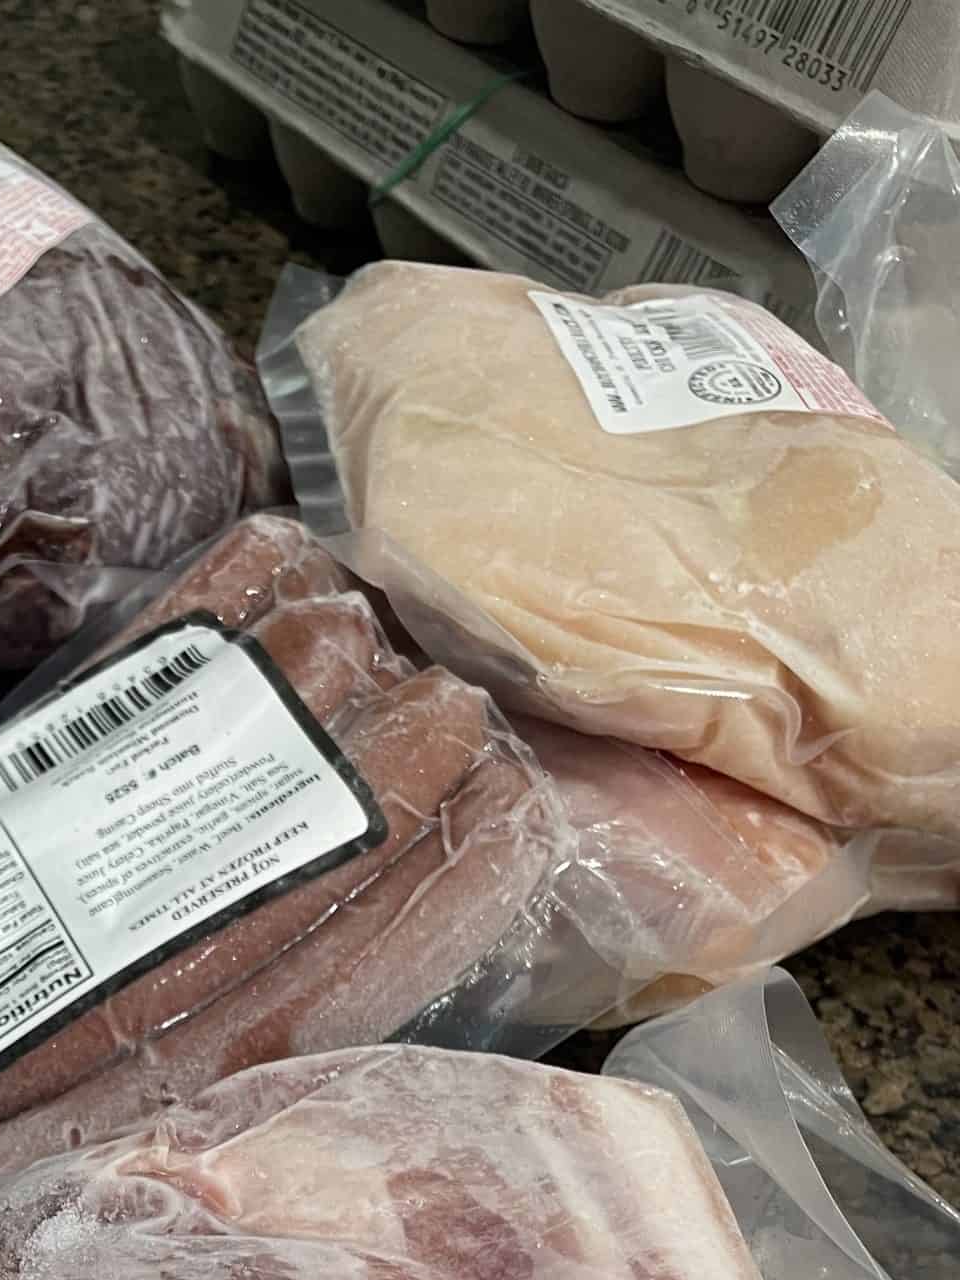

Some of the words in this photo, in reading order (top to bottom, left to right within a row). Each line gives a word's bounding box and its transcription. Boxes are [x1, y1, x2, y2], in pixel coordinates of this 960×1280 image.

[717, 9, 779, 55] 51497
[781, 45, 847, 91] 28033
[157, 743, 202, 774] Batch
[170, 779, 195, 799] into
[133, 790, 172, 819] Sheep
[270, 820, 308, 845] KEEP
[215, 844, 266, 877] FROZEN
[169, 870, 250, 922] PRESERVED
[171, 885, 198, 905] ALL
[197, 874, 216, 889] AT
